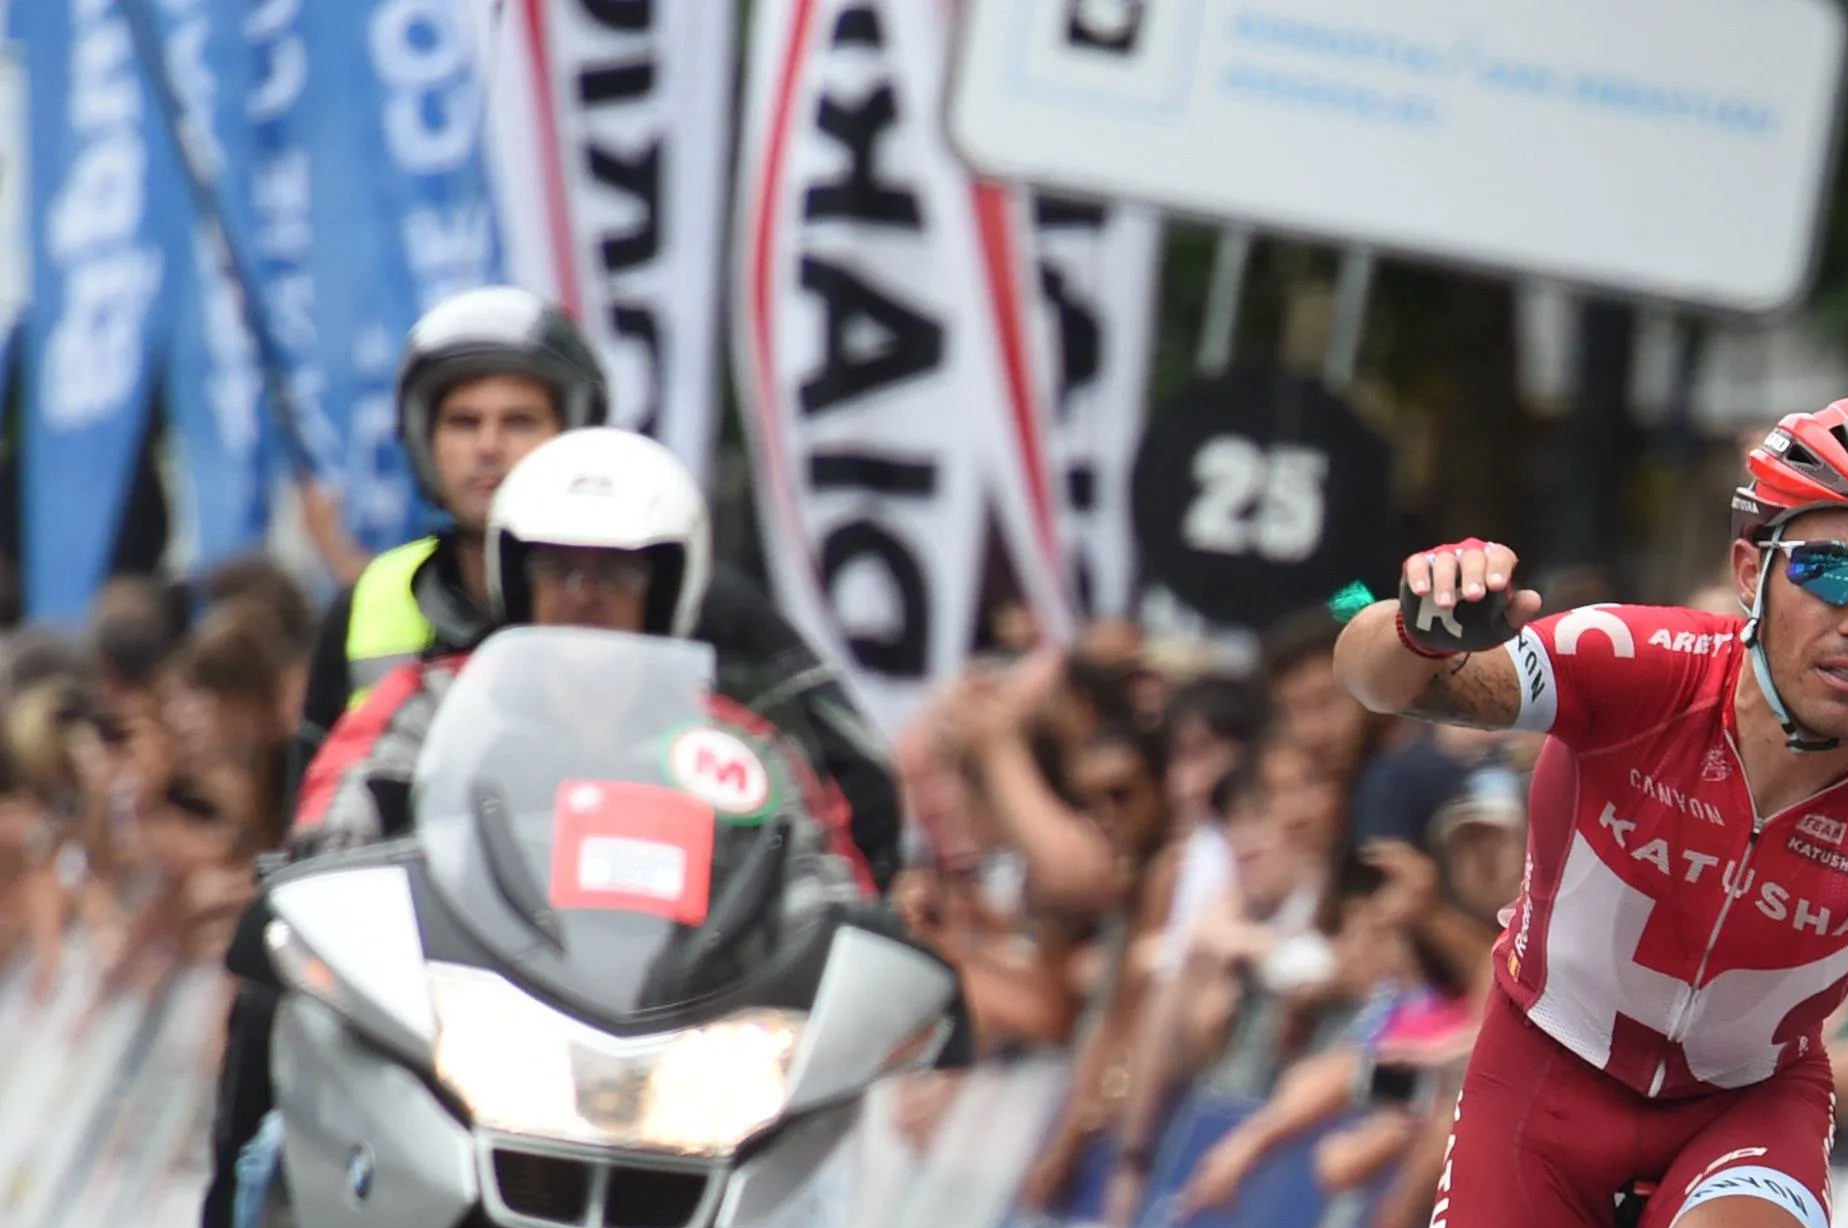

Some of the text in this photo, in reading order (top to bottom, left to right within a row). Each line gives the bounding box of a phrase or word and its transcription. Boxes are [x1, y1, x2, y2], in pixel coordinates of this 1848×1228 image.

[1181, 432, 1329, 565] 25
[1648, 627, 1734, 658] ARET
[1629, 767, 1726, 828] CANYON
